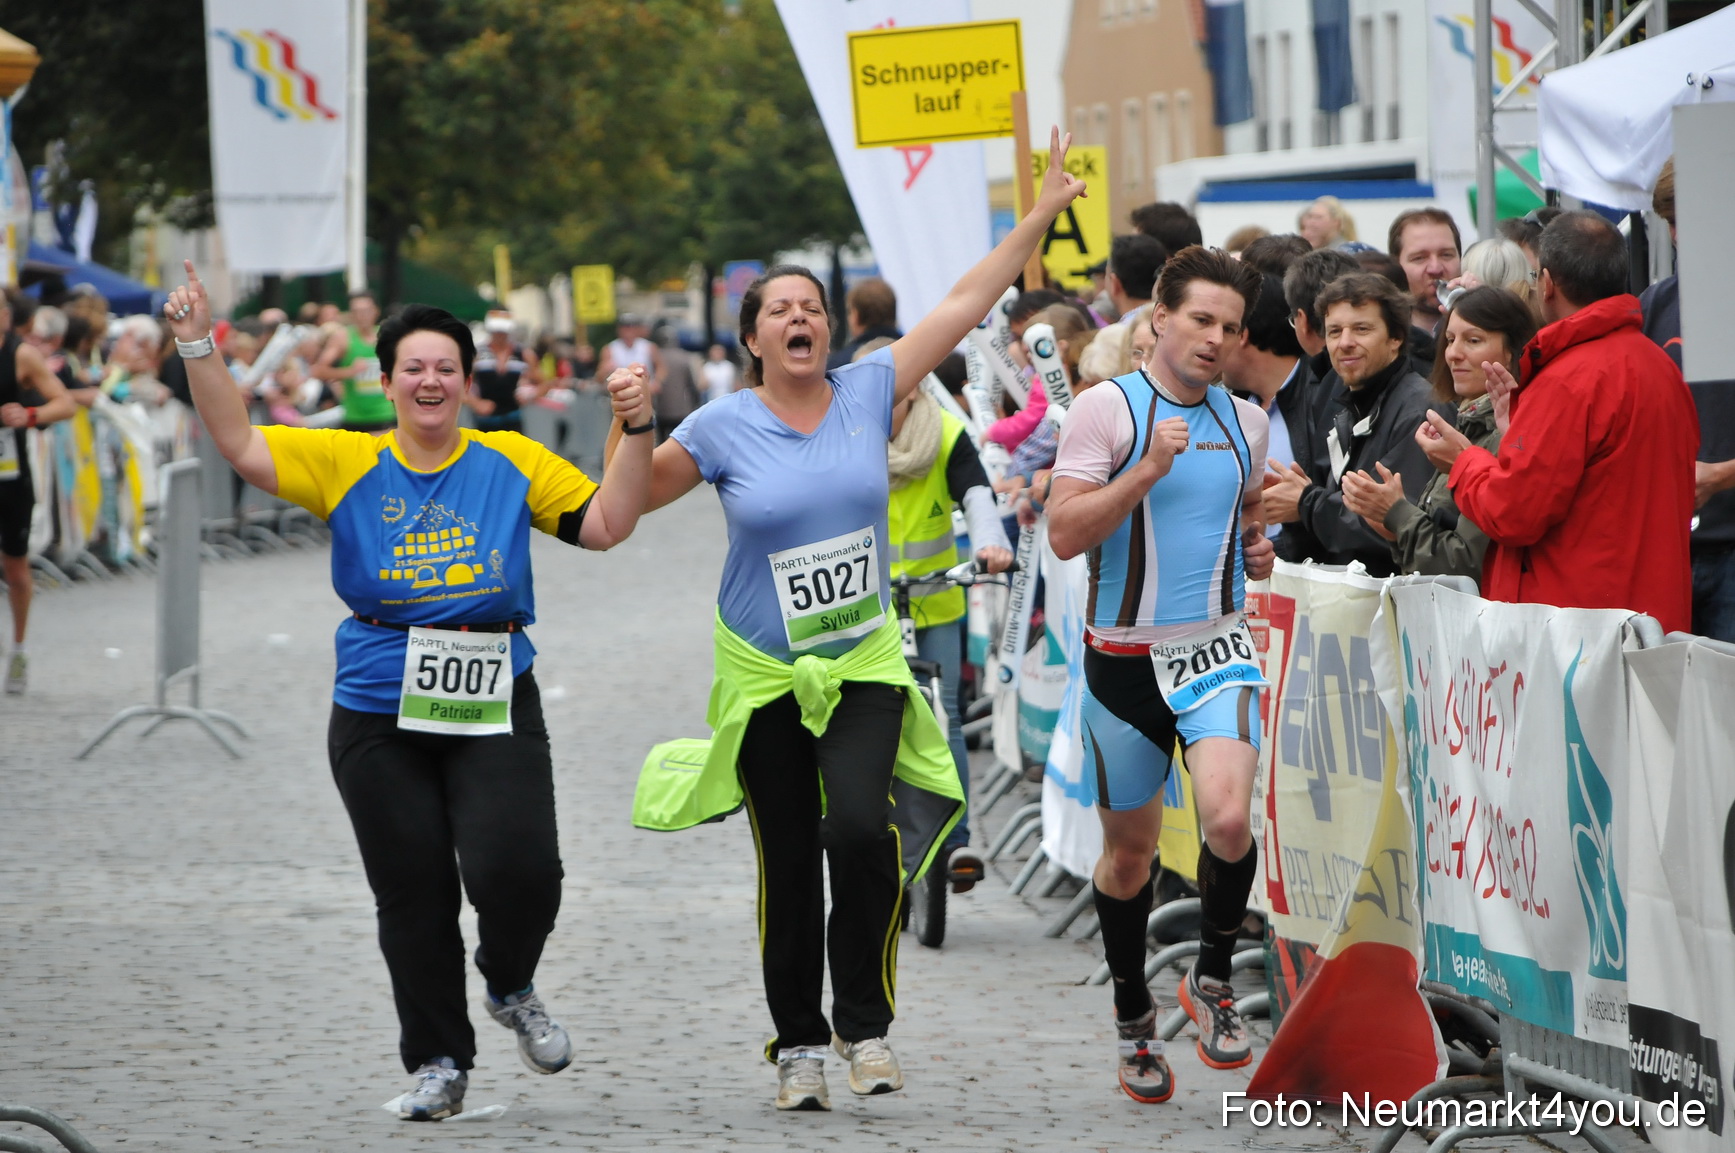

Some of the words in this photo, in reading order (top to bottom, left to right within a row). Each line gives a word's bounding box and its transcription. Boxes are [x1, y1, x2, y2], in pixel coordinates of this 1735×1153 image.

[861, 58, 1010, 86] Schnupper-
[914, 89, 962, 114] lauf
[1031, 152, 1097, 177] Blck
[1043, 205, 1088, 255] A
[774, 556, 811, 572] PARTL
[812, 542, 861, 563] Neumarkt
[788, 553, 870, 611] 5027
[820, 609, 860, 631] Sylvia
[411, 637, 448, 650] PARTL
[451, 641, 496, 652] Neumarkt
[416, 654, 503, 694] 5007
[1191, 668, 1245, 697] Michael
[429, 702, 483, 720] Patricia
